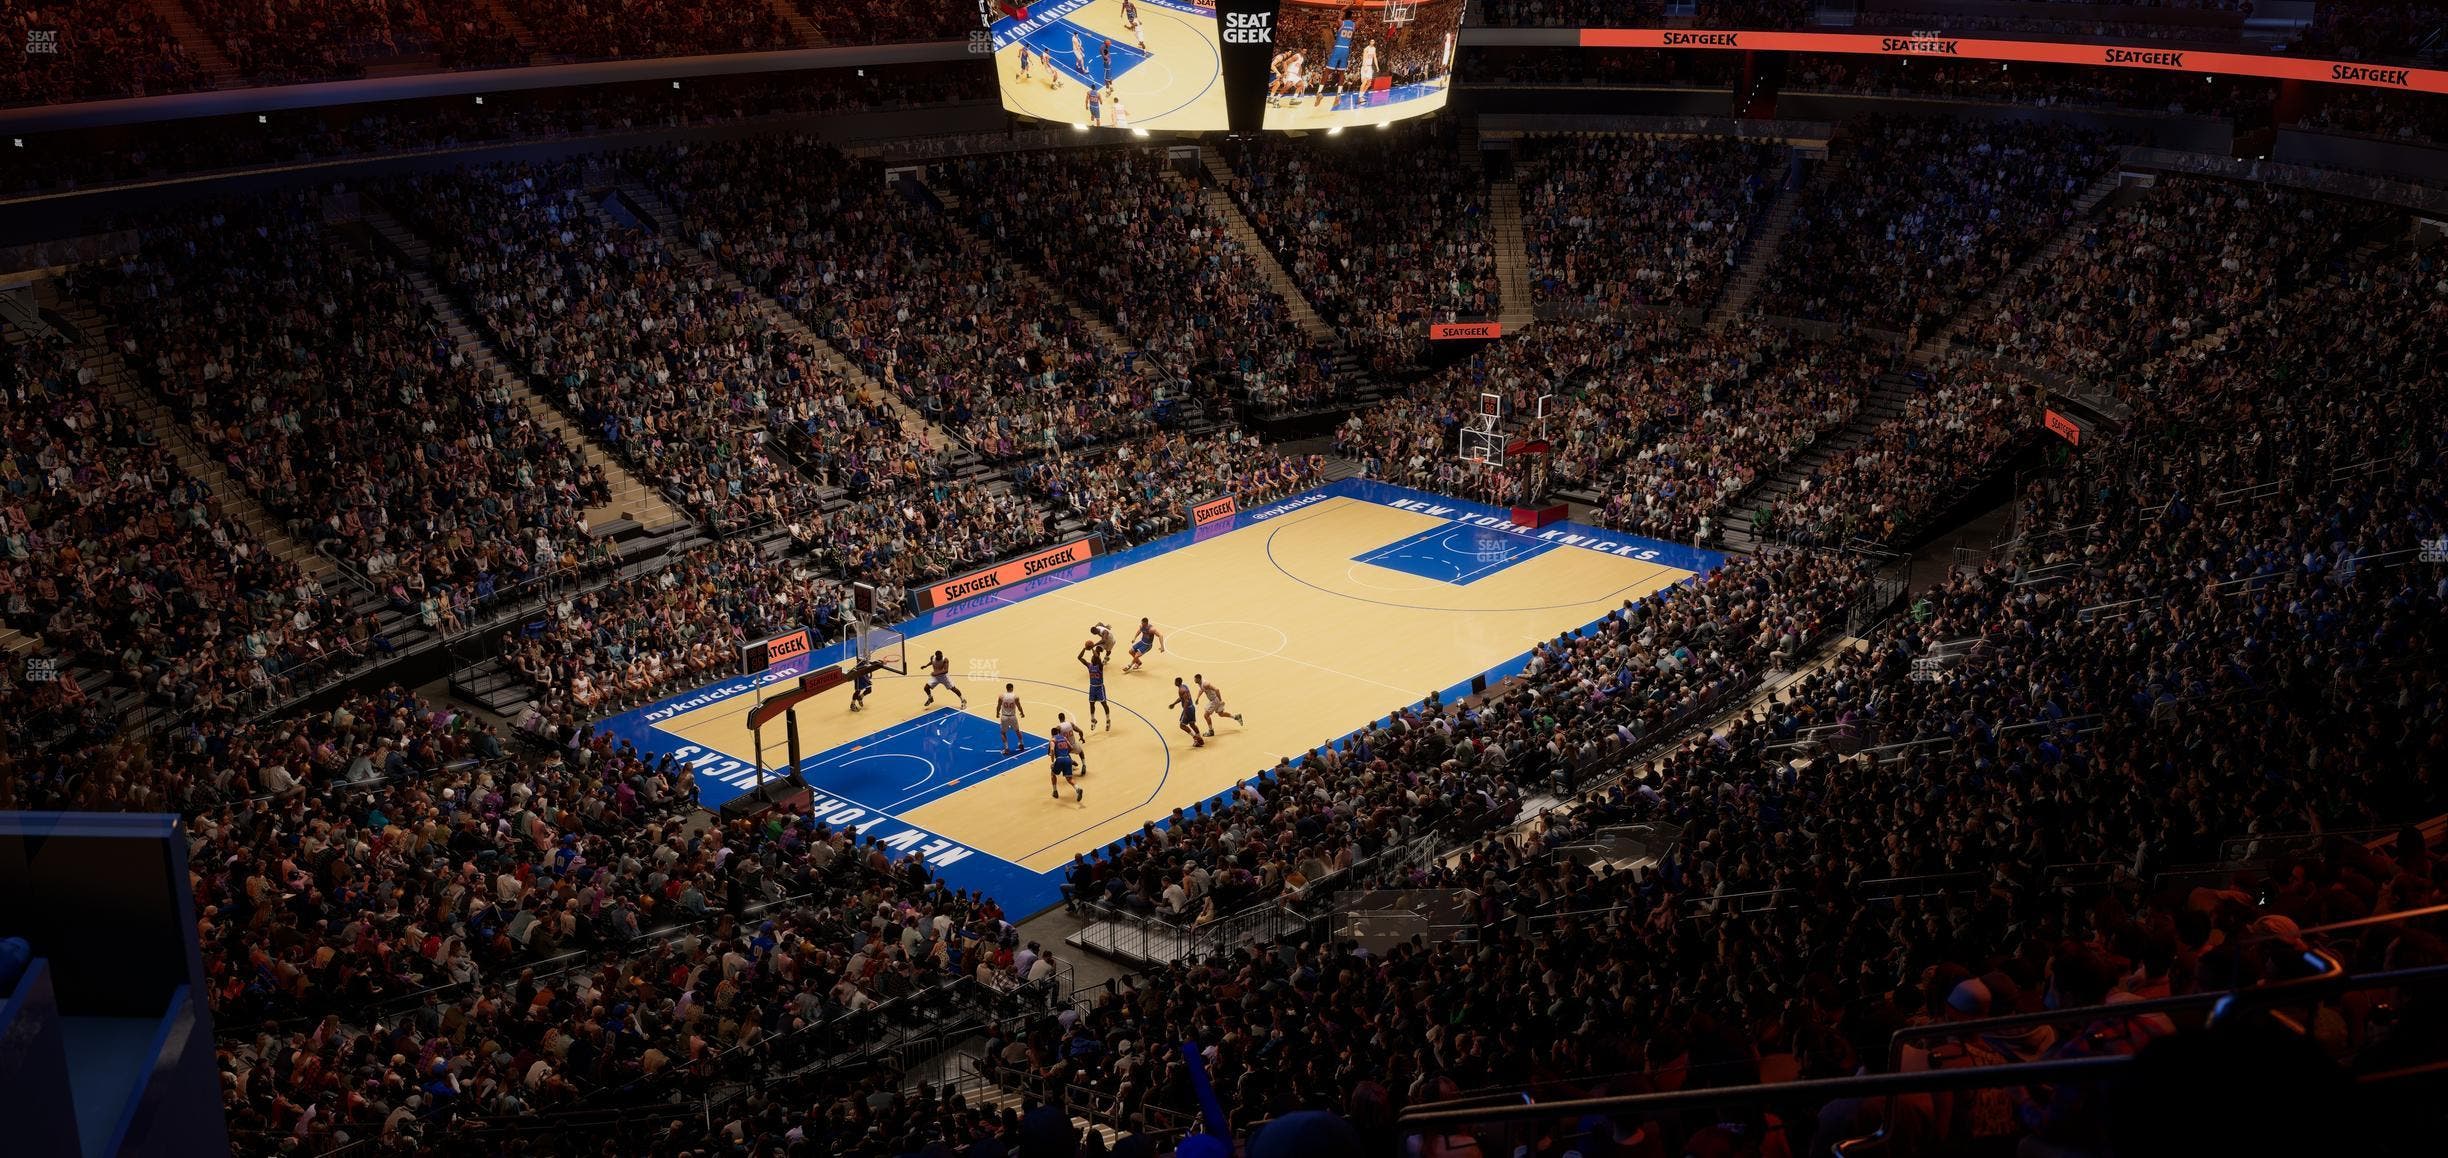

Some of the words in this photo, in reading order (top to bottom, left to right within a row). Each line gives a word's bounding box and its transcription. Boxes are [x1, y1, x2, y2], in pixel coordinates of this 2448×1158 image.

[1004, 18, 1042, 40] YORK
[1226, 12, 1271, 28] SEAT
[1223, 28, 1272, 43] GEEK
[1663, 32, 1738, 46] SEATGEEK
[1882, 38, 1958, 54] SEATGEEK
[2105, 49, 2183, 67] SEATGEEK
[2332, 65, 2409, 86] SEATGEEK
[1442, 327, 1489, 337] SEATGEEK
[1196, 501, 1233, 522] SEATGEEK
[1252, 494, 1327, 519] @nyknicks
[1388, 499, 1454, 516] NEW
[1457, 512, 1532, 535] YORK
[1537, 529, 1660, 561] KNICKS
[1024, 548, 1076, 576] SEATGEEK
[945, 572, 1000, 601] SEATGEEK
[769, 636, 806, 658] ATGEEK
[644, 667, 798, 721] nyknicks.com
[675, 746, 777, 790] NICKS
[813, 791, 887, 836] YOR
[884, 829, 974, 867] NEW
